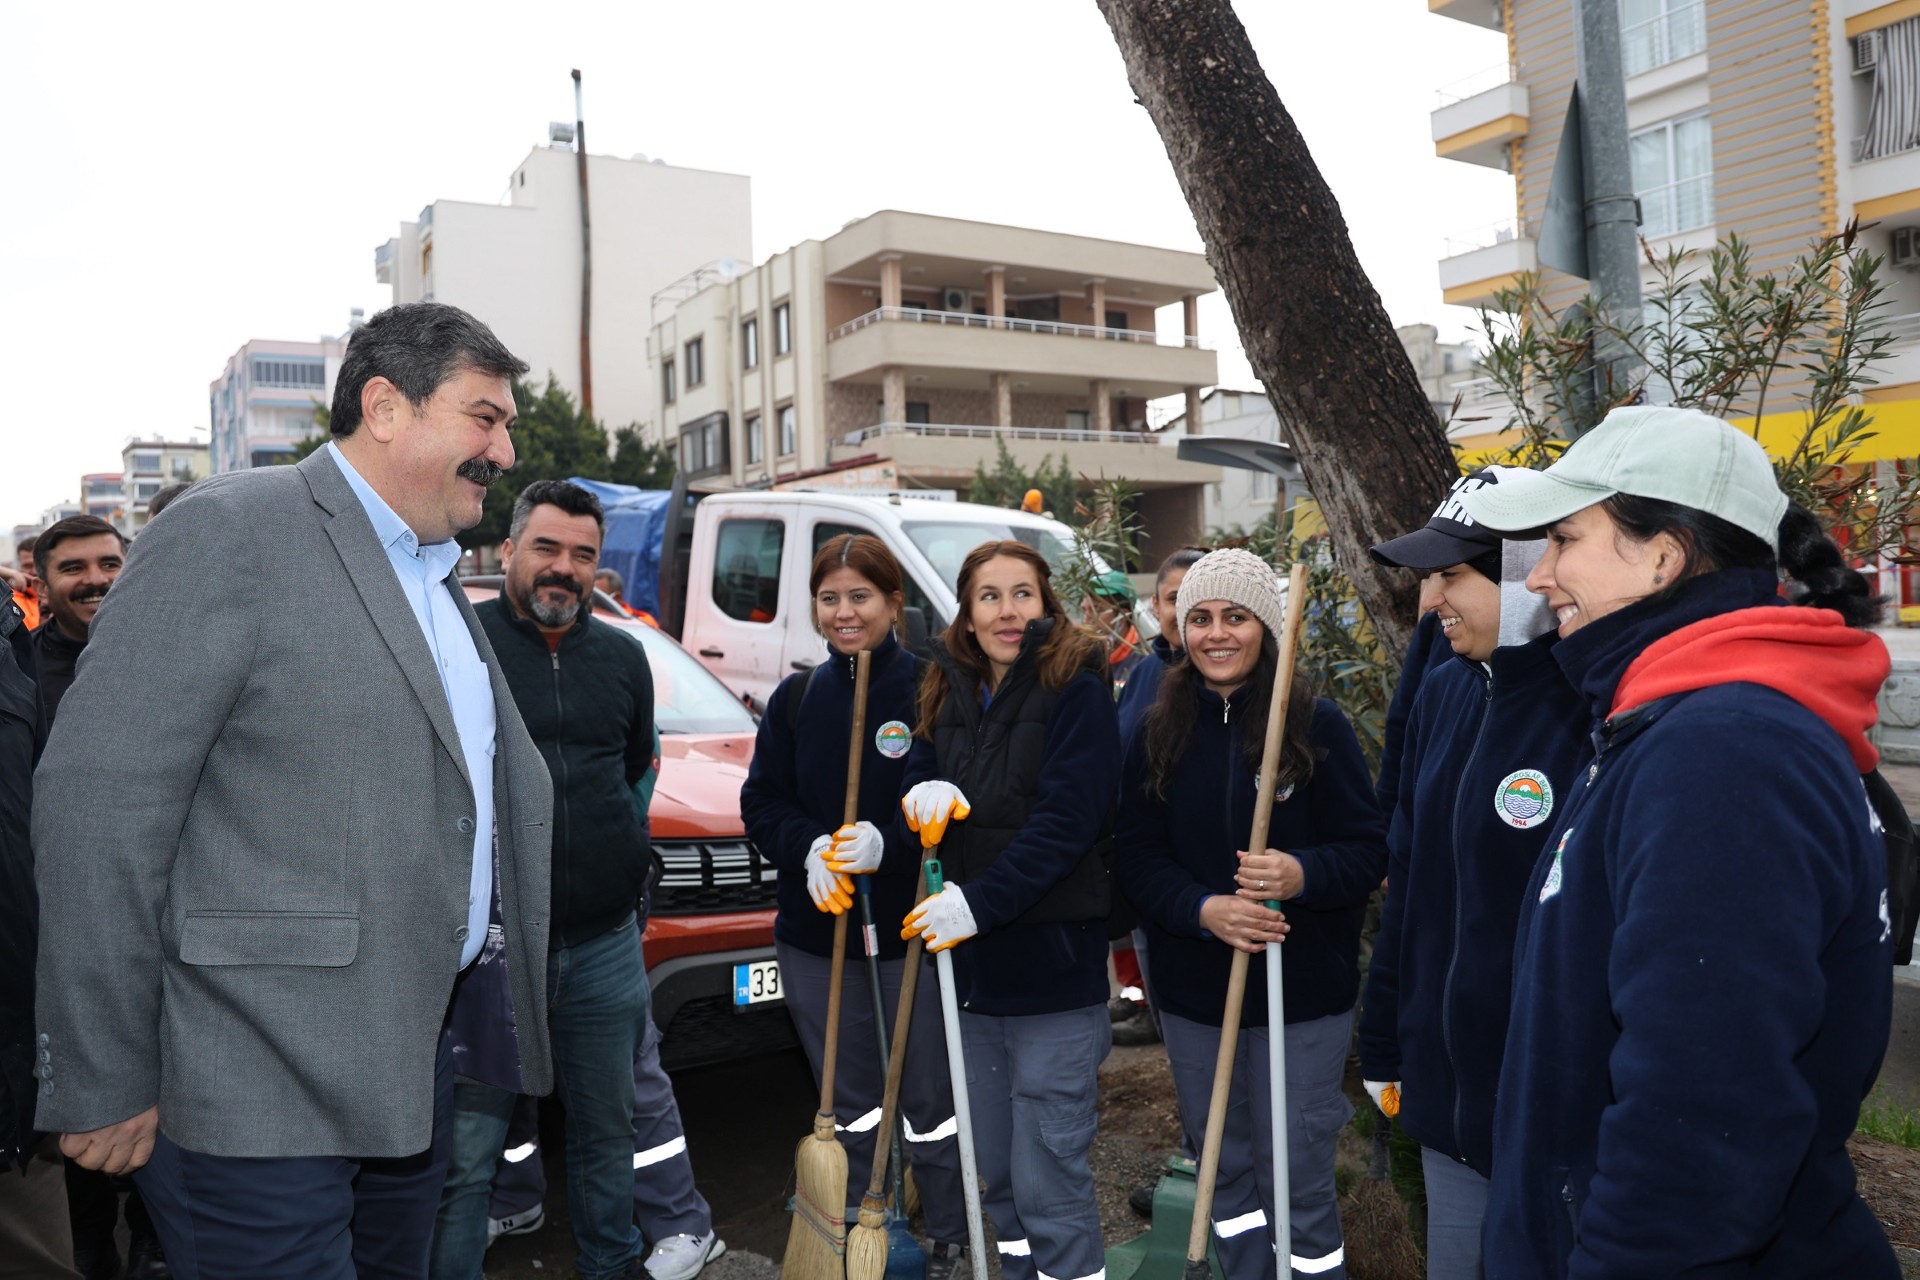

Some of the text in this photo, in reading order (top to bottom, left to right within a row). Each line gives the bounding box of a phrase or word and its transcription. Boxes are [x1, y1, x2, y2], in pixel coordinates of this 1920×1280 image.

[1505, 771, 1541, 784] TOROSLAR
[1511, 818, 1528, 827] 1994
[737, 966, 778, 997] TR 33
